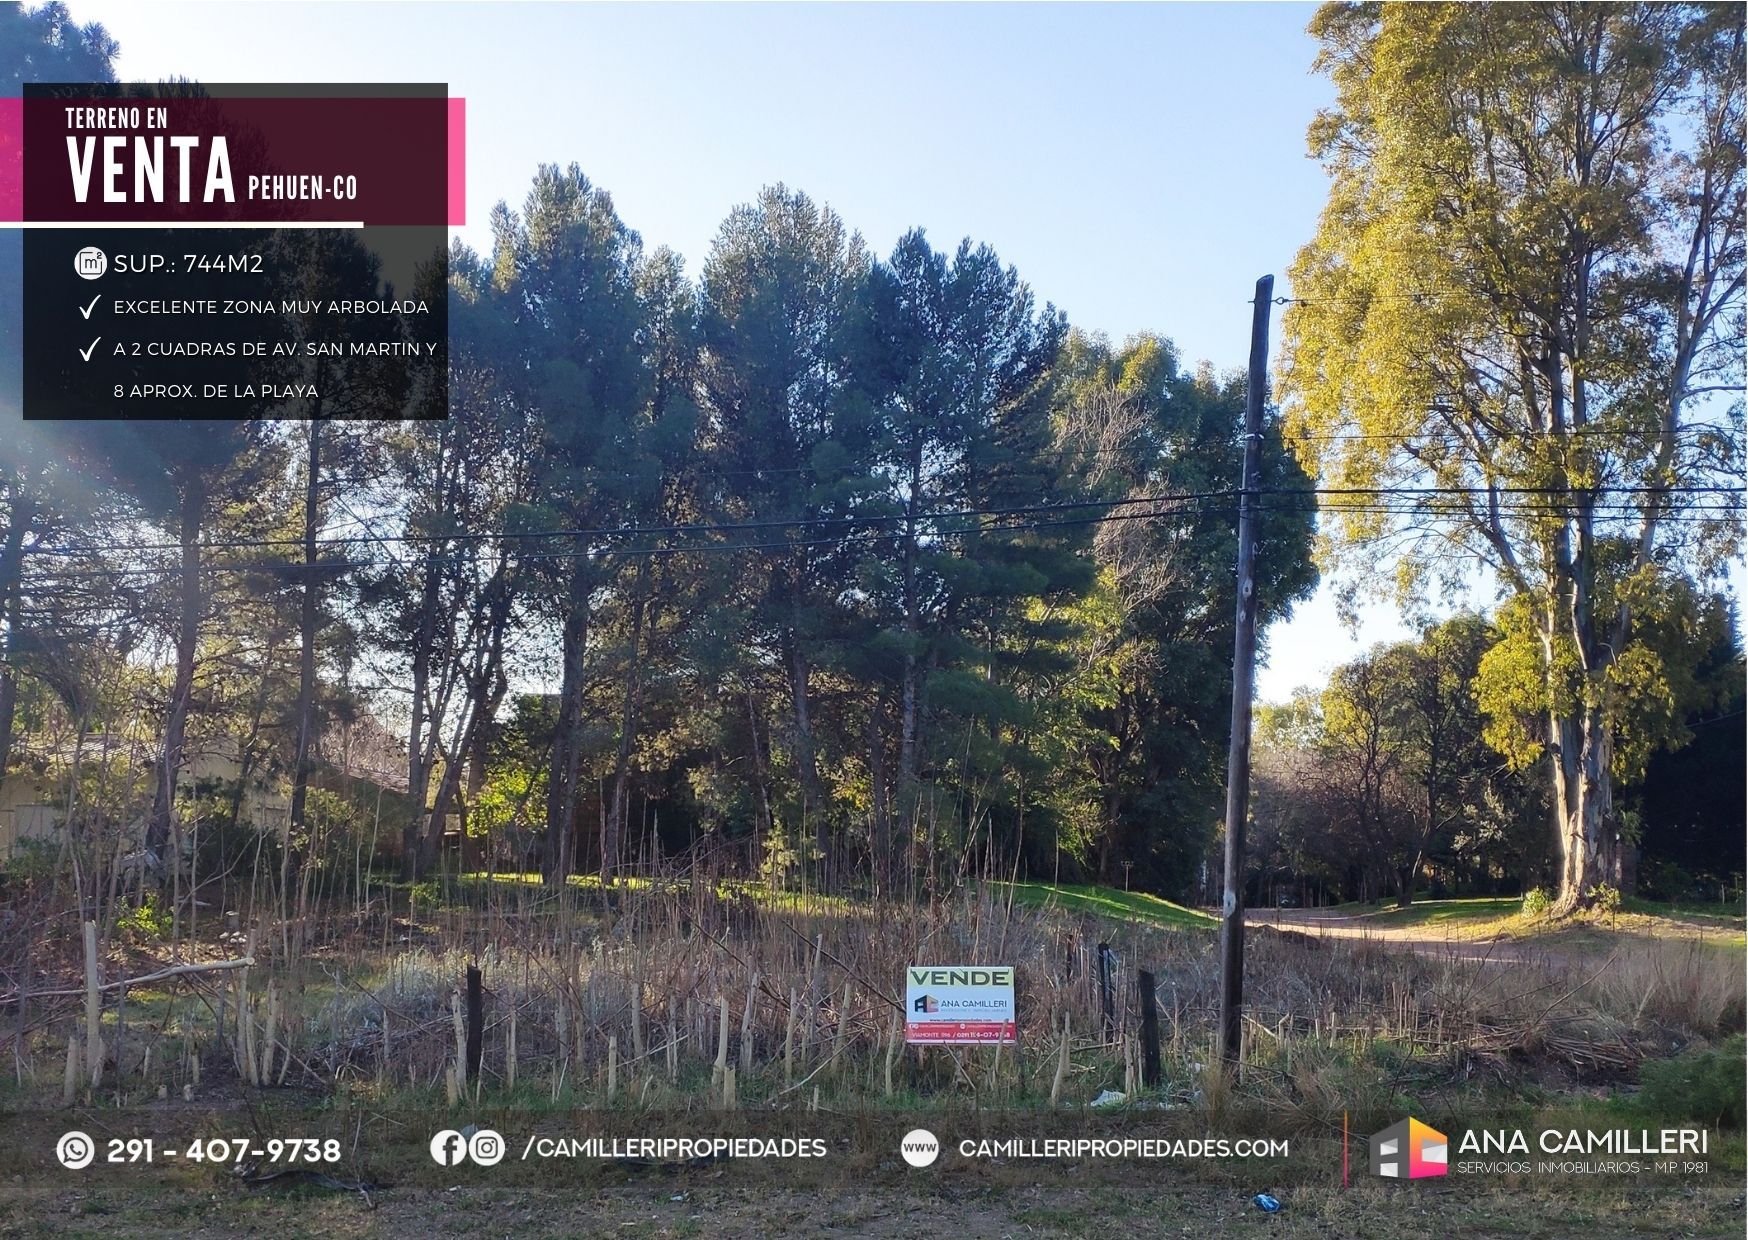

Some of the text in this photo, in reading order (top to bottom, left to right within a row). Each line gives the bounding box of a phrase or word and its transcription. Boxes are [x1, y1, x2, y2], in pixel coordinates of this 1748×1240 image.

[910, 970, 1009, 986] VENDE
[941, 1000, 1007, 1008] ANA CAMILLERI
